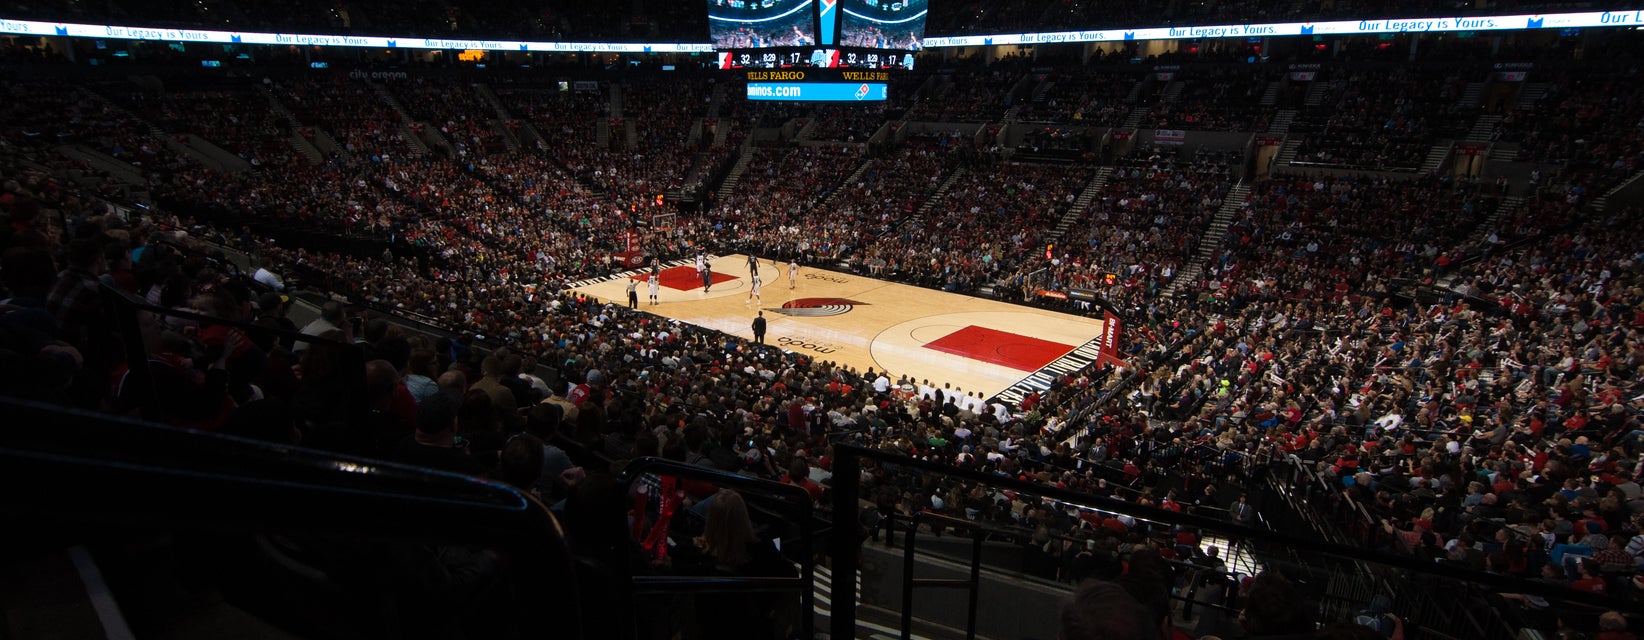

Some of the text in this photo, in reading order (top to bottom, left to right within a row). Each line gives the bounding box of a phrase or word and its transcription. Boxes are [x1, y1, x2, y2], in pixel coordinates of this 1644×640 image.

[1601, 11, 1630, 23] Our
[1359, 17, 1498, 32] Our Legacy is Yours.
[105, 25, 123, 36] Our
[127, 27, 163, 40] Legacy
[167, 29, 176, 39] is
[1020, 31, 1106, 42] Our Legacy is Yours.
[1169, 25, 1277, 38] Our Legacy is Yours.
[276, 33, 292, 43] Our
[296, 34, 330, 45] Legacy
[332, 35, 340, 44] is
[424, 39, 438, 47] Our
[441, 40, 468, 50] Legacy
[471, 41, 478, 49] is
[554, 42, 567, 50] Our
[570, 43, 597, 51] Legacy
[598, 43, 605, 51] is
[676, 43, 713, 52] Our Legac
[741, 52, 801, 64] 32 8:29 17
[847, 53, 897, 65] 32 8:29 17
[770, 71, 804, 80] FARGO
[842, 71, 876, 80] WELLS
[777, 336, 836, 354] moda
